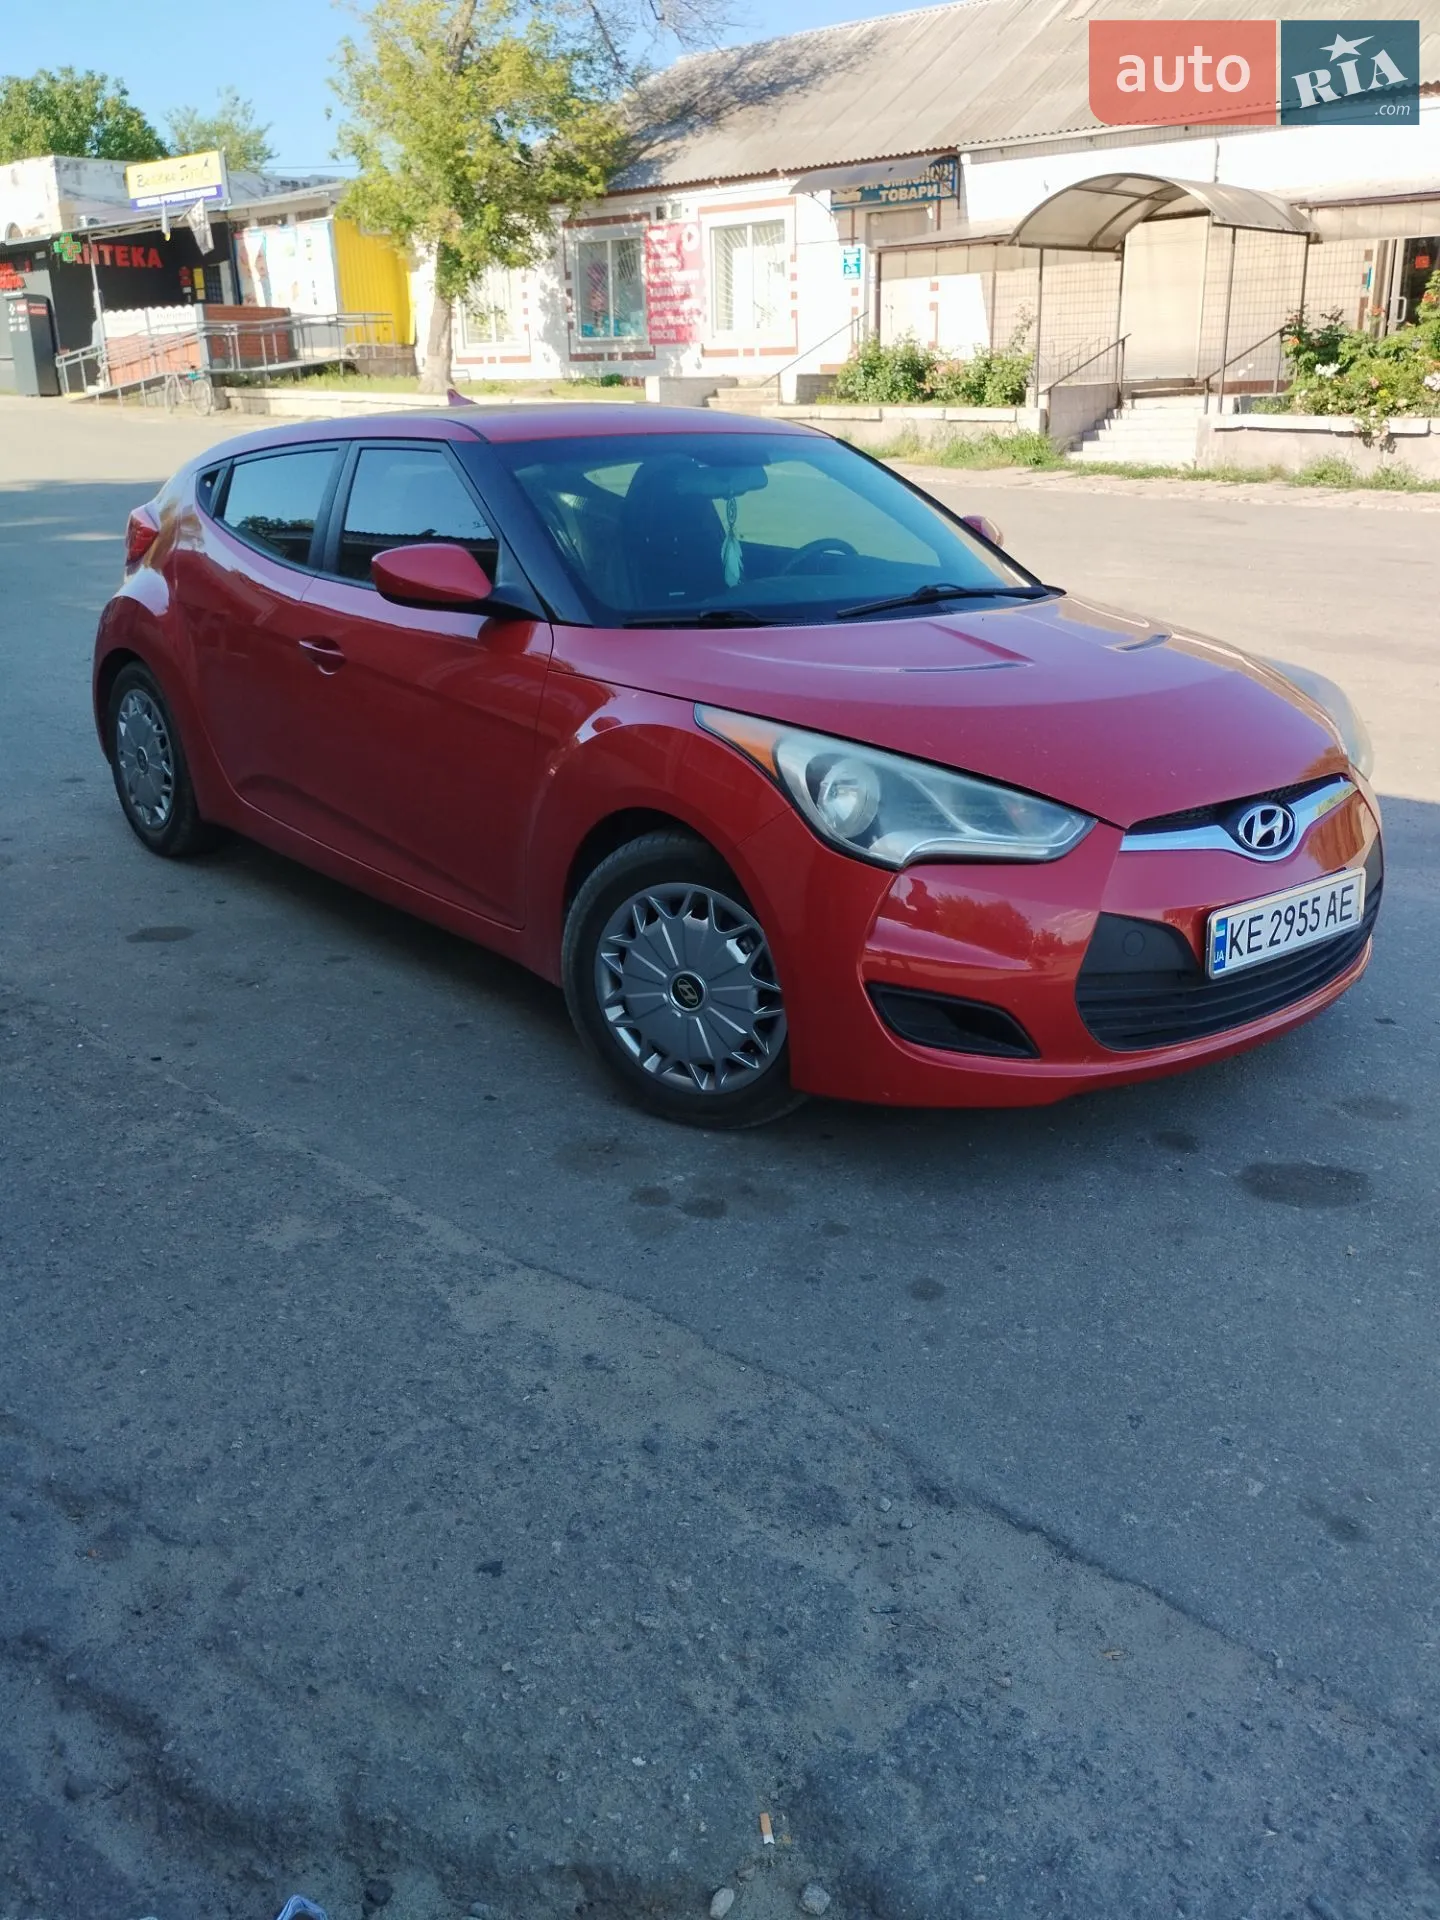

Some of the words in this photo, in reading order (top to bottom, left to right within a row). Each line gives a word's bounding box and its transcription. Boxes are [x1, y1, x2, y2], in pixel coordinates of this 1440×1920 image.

[879, 184, 938, 202] ТОВАРИ
[1228, 914, 1264, 960] KE
[1267, 895, 1321, 948] 2955
[1325, 884, 1354, 928] AE
